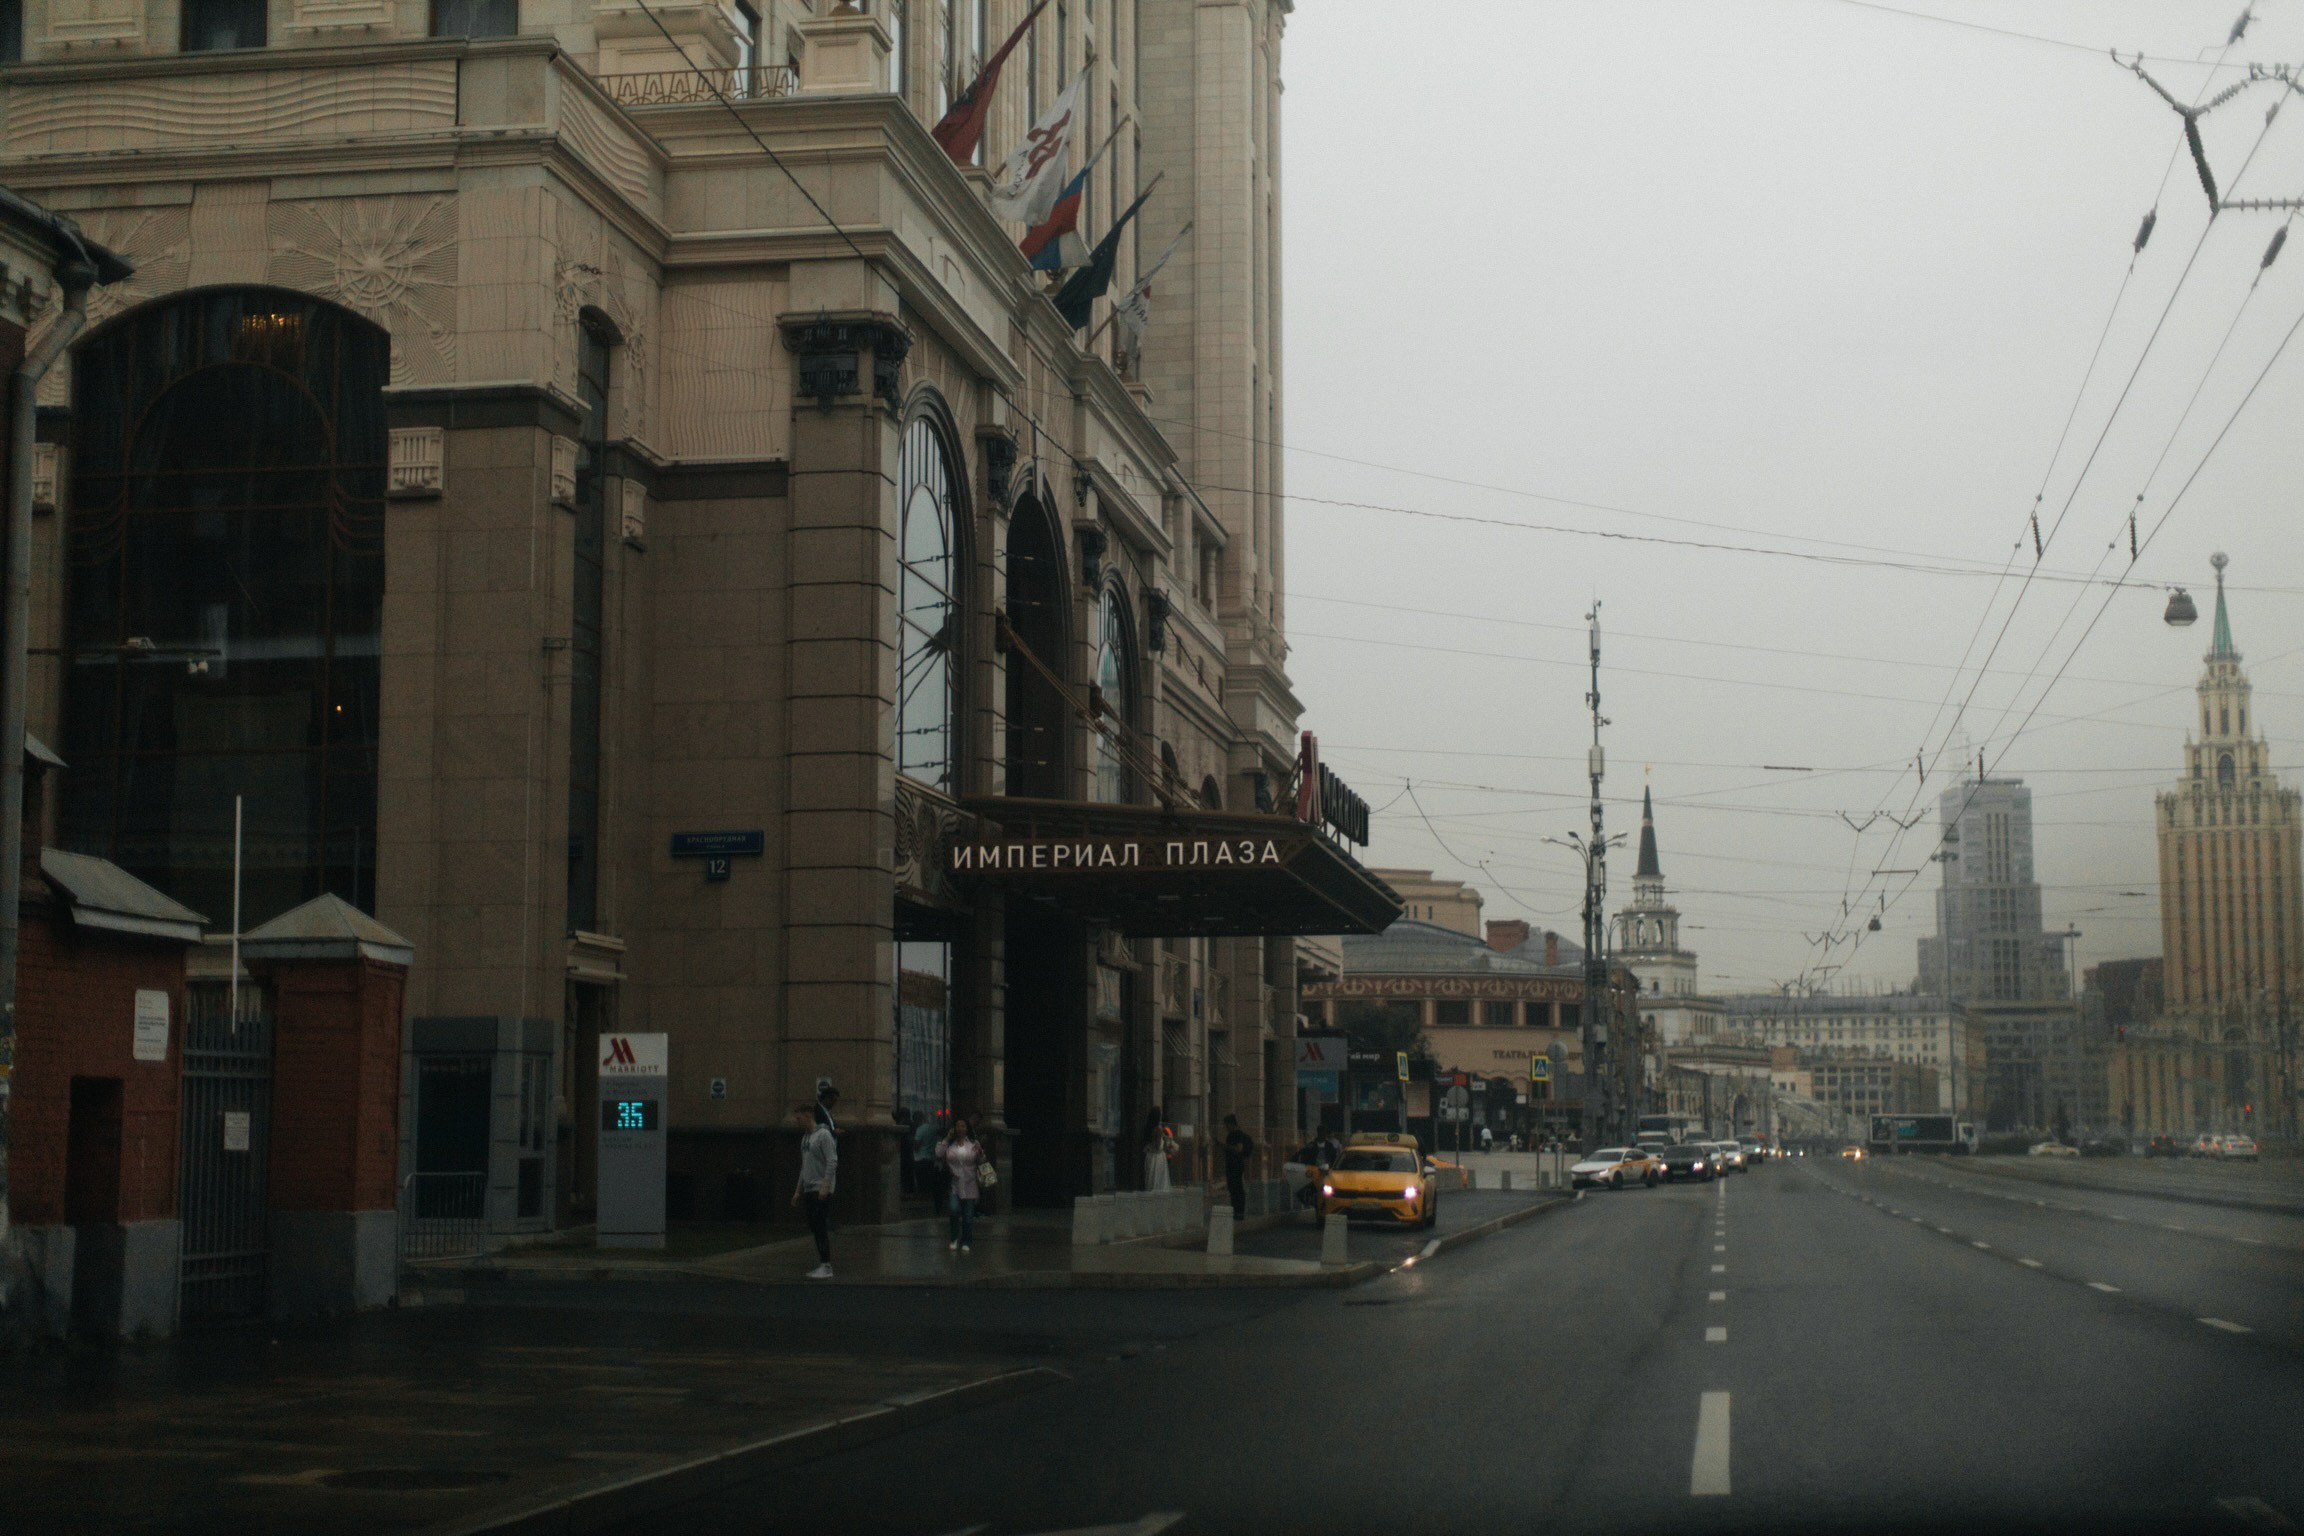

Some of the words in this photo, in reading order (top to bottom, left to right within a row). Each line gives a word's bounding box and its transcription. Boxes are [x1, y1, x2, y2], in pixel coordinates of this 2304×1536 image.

[953, 843, 1139, 869] ИМПЕРИАЛ
[1165, 840, 1280, 865] ПЛАЗА
[709, 859, 726, 874] 12
[609, 1065, 660, 1073] MARRIOTT
